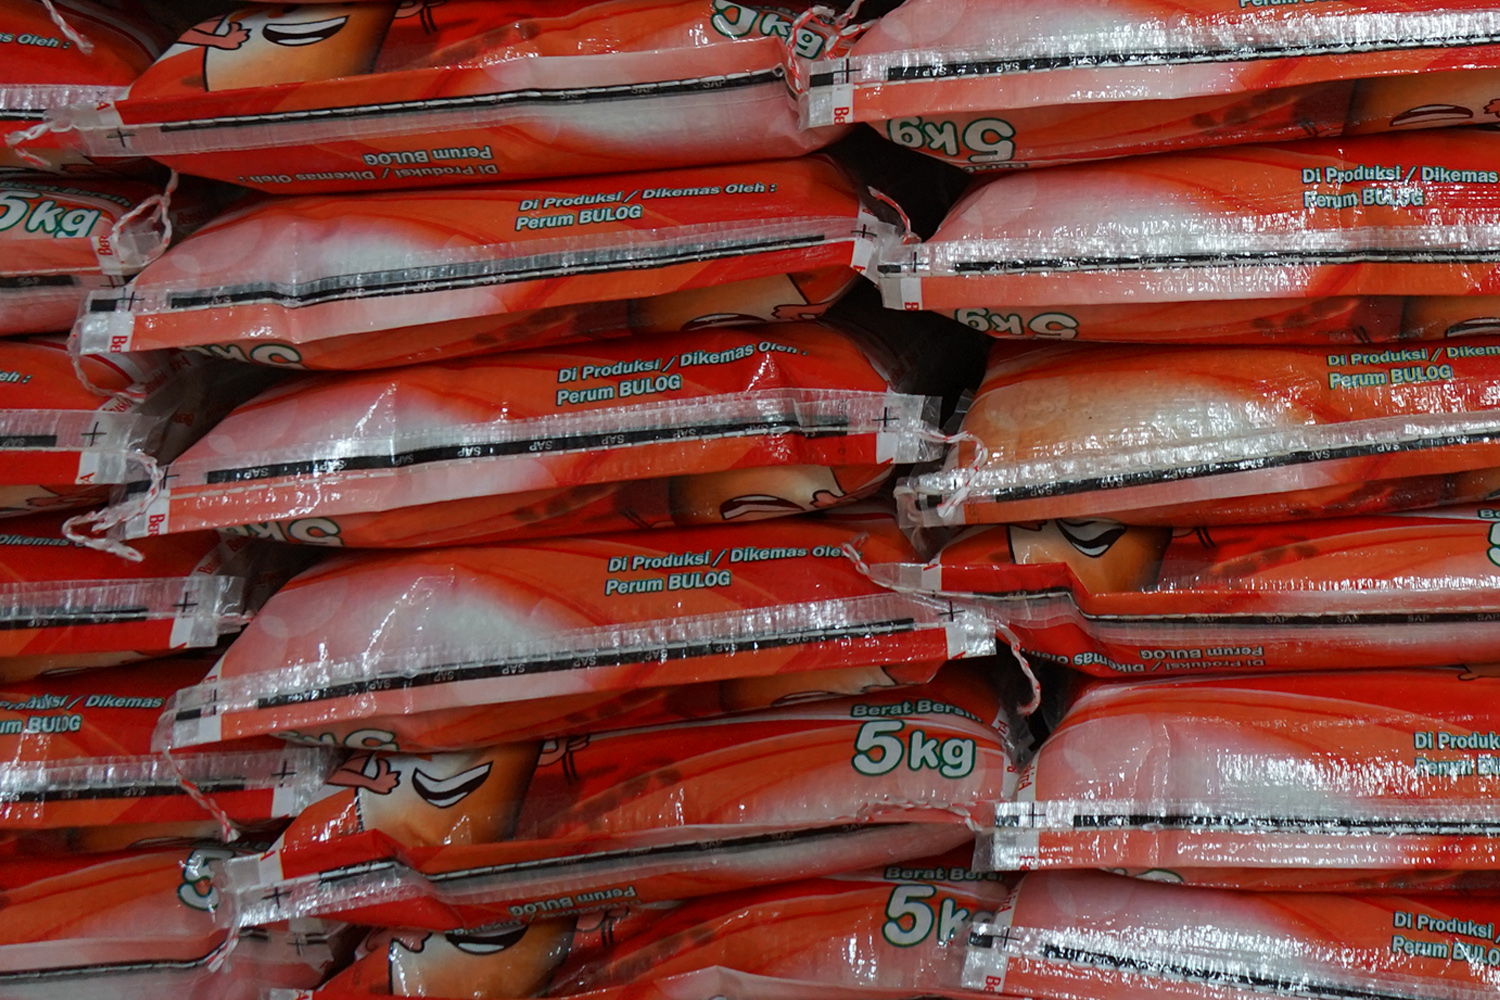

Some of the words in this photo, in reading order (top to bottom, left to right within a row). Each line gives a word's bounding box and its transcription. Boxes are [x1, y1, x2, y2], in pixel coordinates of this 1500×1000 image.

[18, 34, 60, 47] Oleh
[887, 116, 1017, 163] 5kg
[362, 150, 429, 165] BULOG
[431, 146, 493, 160] Perum
[520, 199, 539, 211] Di
[543, 191, 623, 209] Produksi
[642, 185, 720, 198] Dikemas
[725, 182, 766, 194] Oleh
[1304, 189, 1359, 209] Perum
[1362, 186, 1425, 207] BULOG
[516, 212, 574, 230] Perum
[579, 205, 643, 225] BULOG
[1327, 354, 1347, 367] Di
[1350, 349, 1428, 365] Produksi
[1329, 370, 1387, 390] Perum
[1391, 365, 1453, 382] BULOG
[556, 387, 614, 406] Perum
[619, 375, 682, 398] BULOG
[606, 577, 664, 596] Perum
[668, 570, 731, 590] BULOG
[1139, 647, 1201, 661] BULOG
[1205, 646, 1264, 658] Perum
[851, 702, 913, 717] Berat
[851, 718, 977, 778] 5kg
[1394, 911, 1413, 928] Di
[1416, 915, 1495, 939] Produksi
[1392, 935, 1450, 960] Perum
